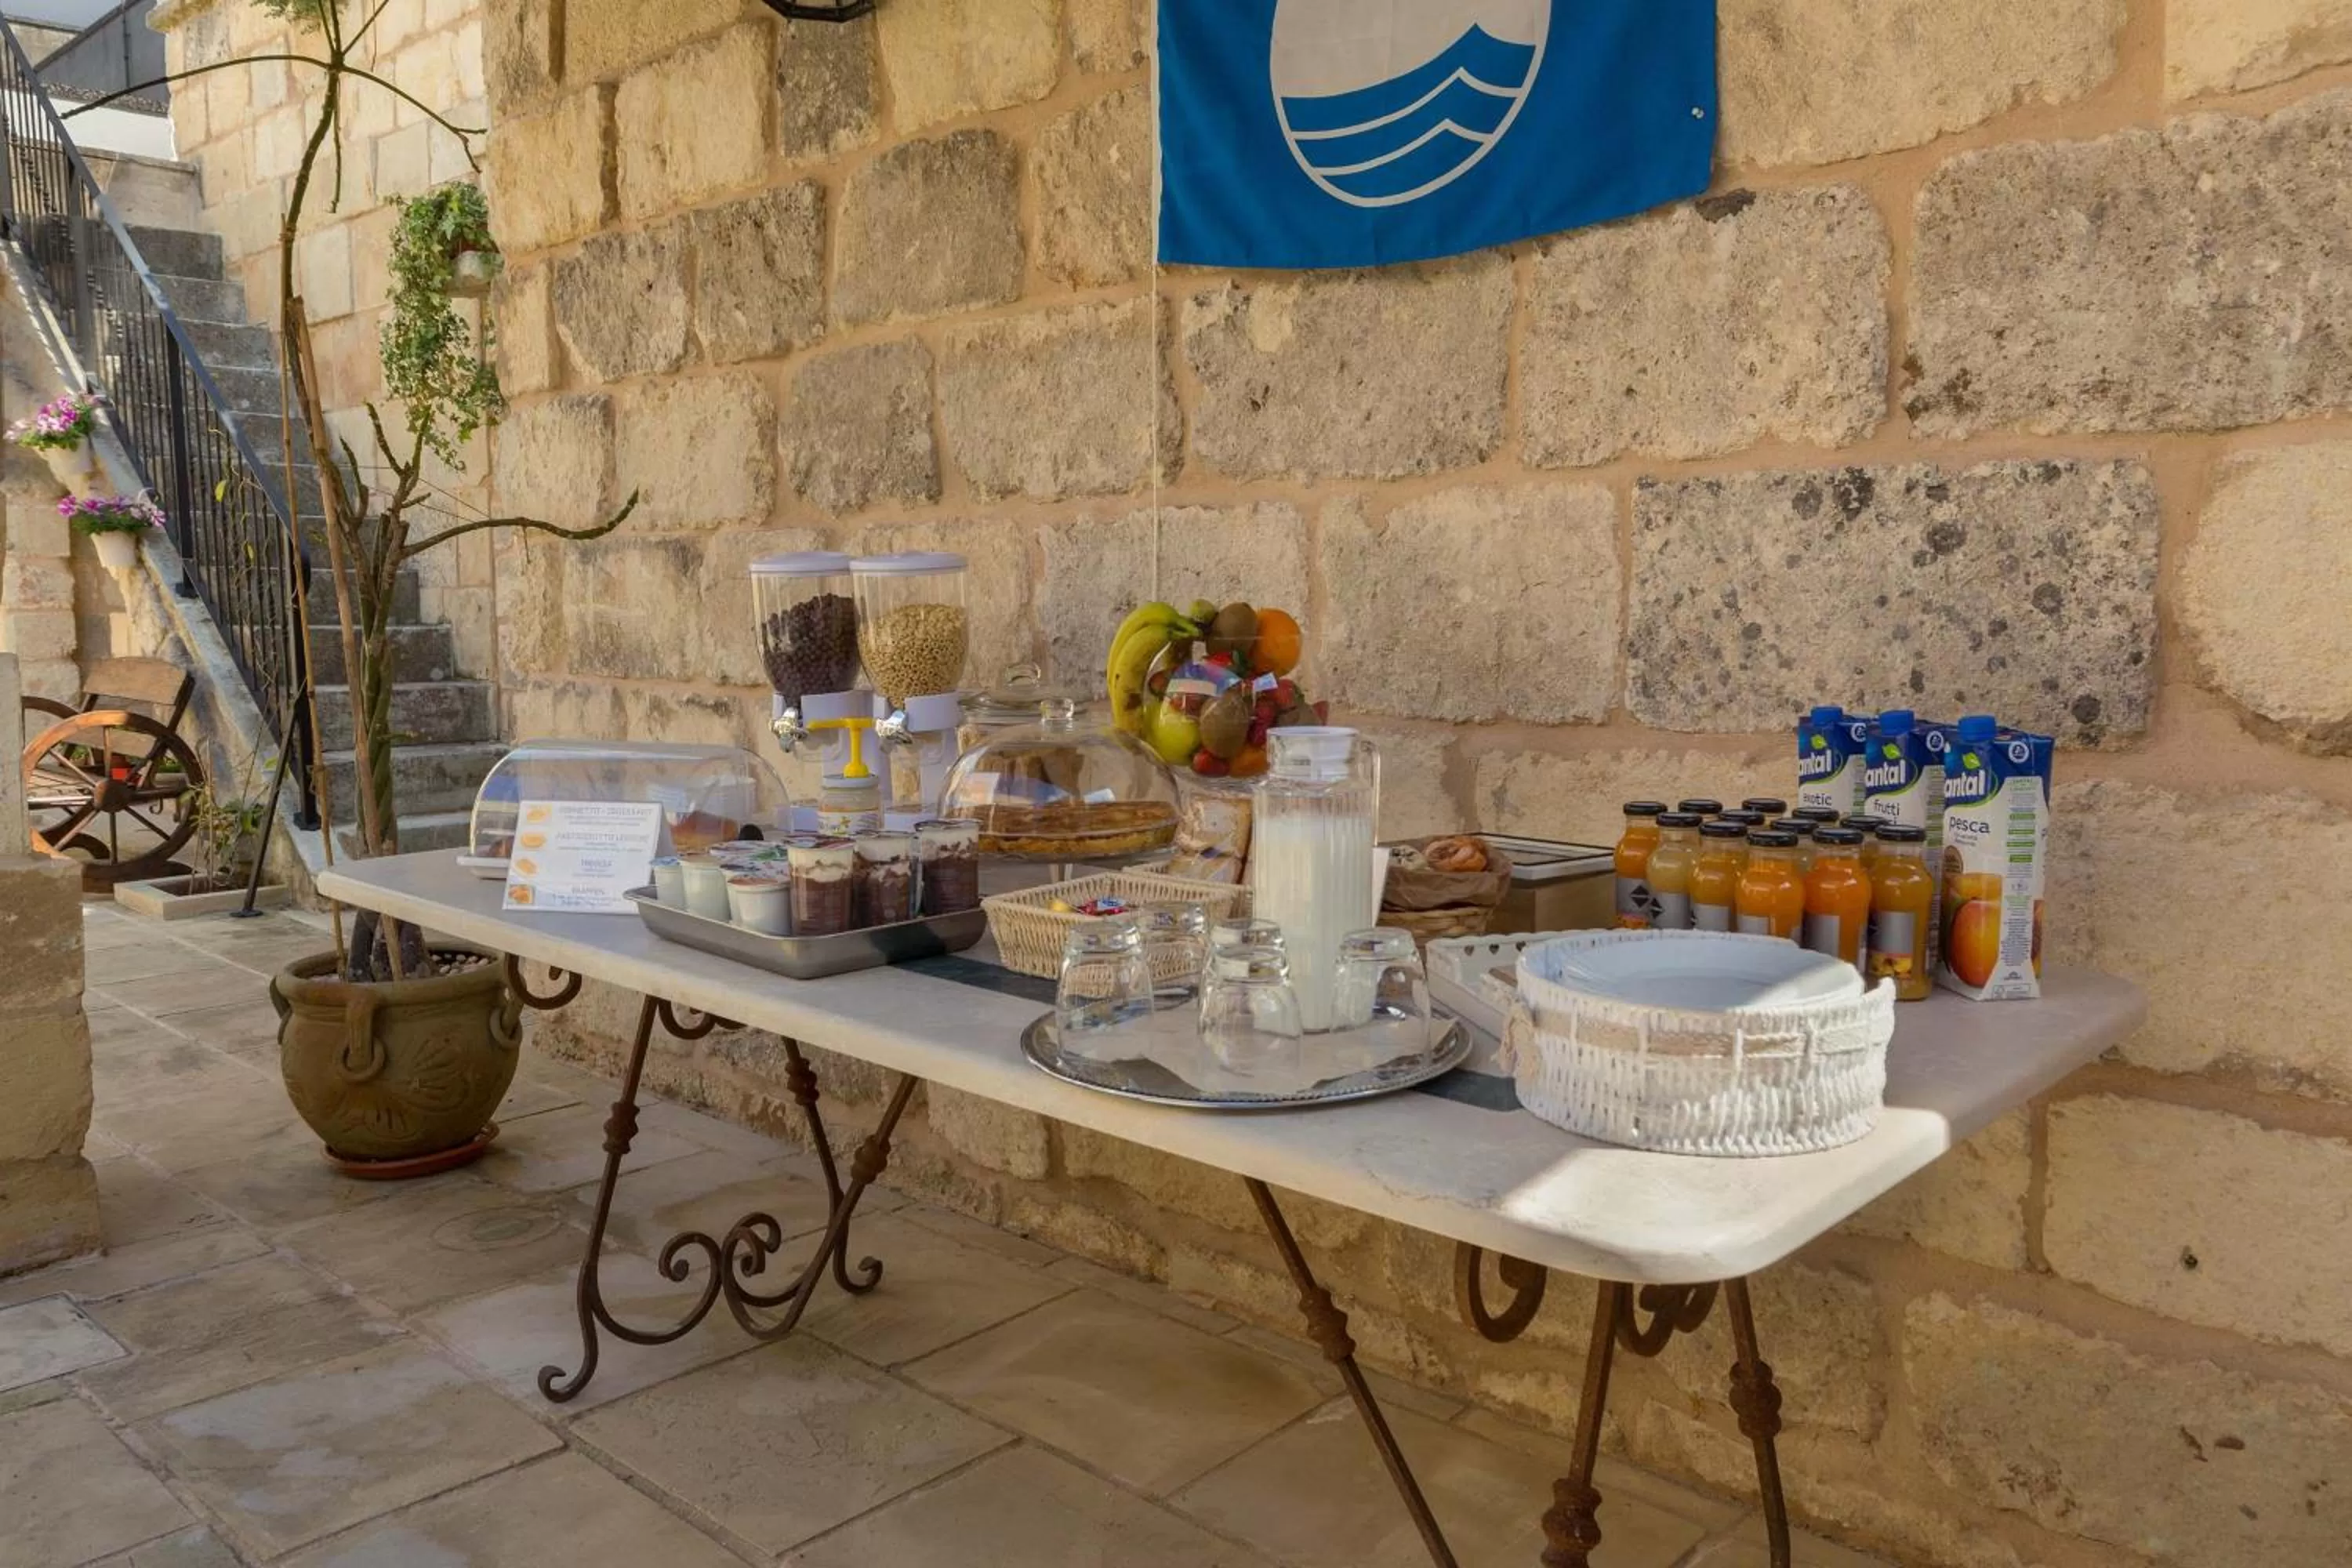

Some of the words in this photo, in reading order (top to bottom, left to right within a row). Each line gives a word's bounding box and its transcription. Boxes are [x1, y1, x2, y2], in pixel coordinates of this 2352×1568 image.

[1798, 750, 1832, 774] antal
[1865, 759, 1906, 787] antal
[1944, 769, 1985, 797] antal
[1873, 799, 1900, 815] frutti
[1949, 815, 1991, 833] pesca
